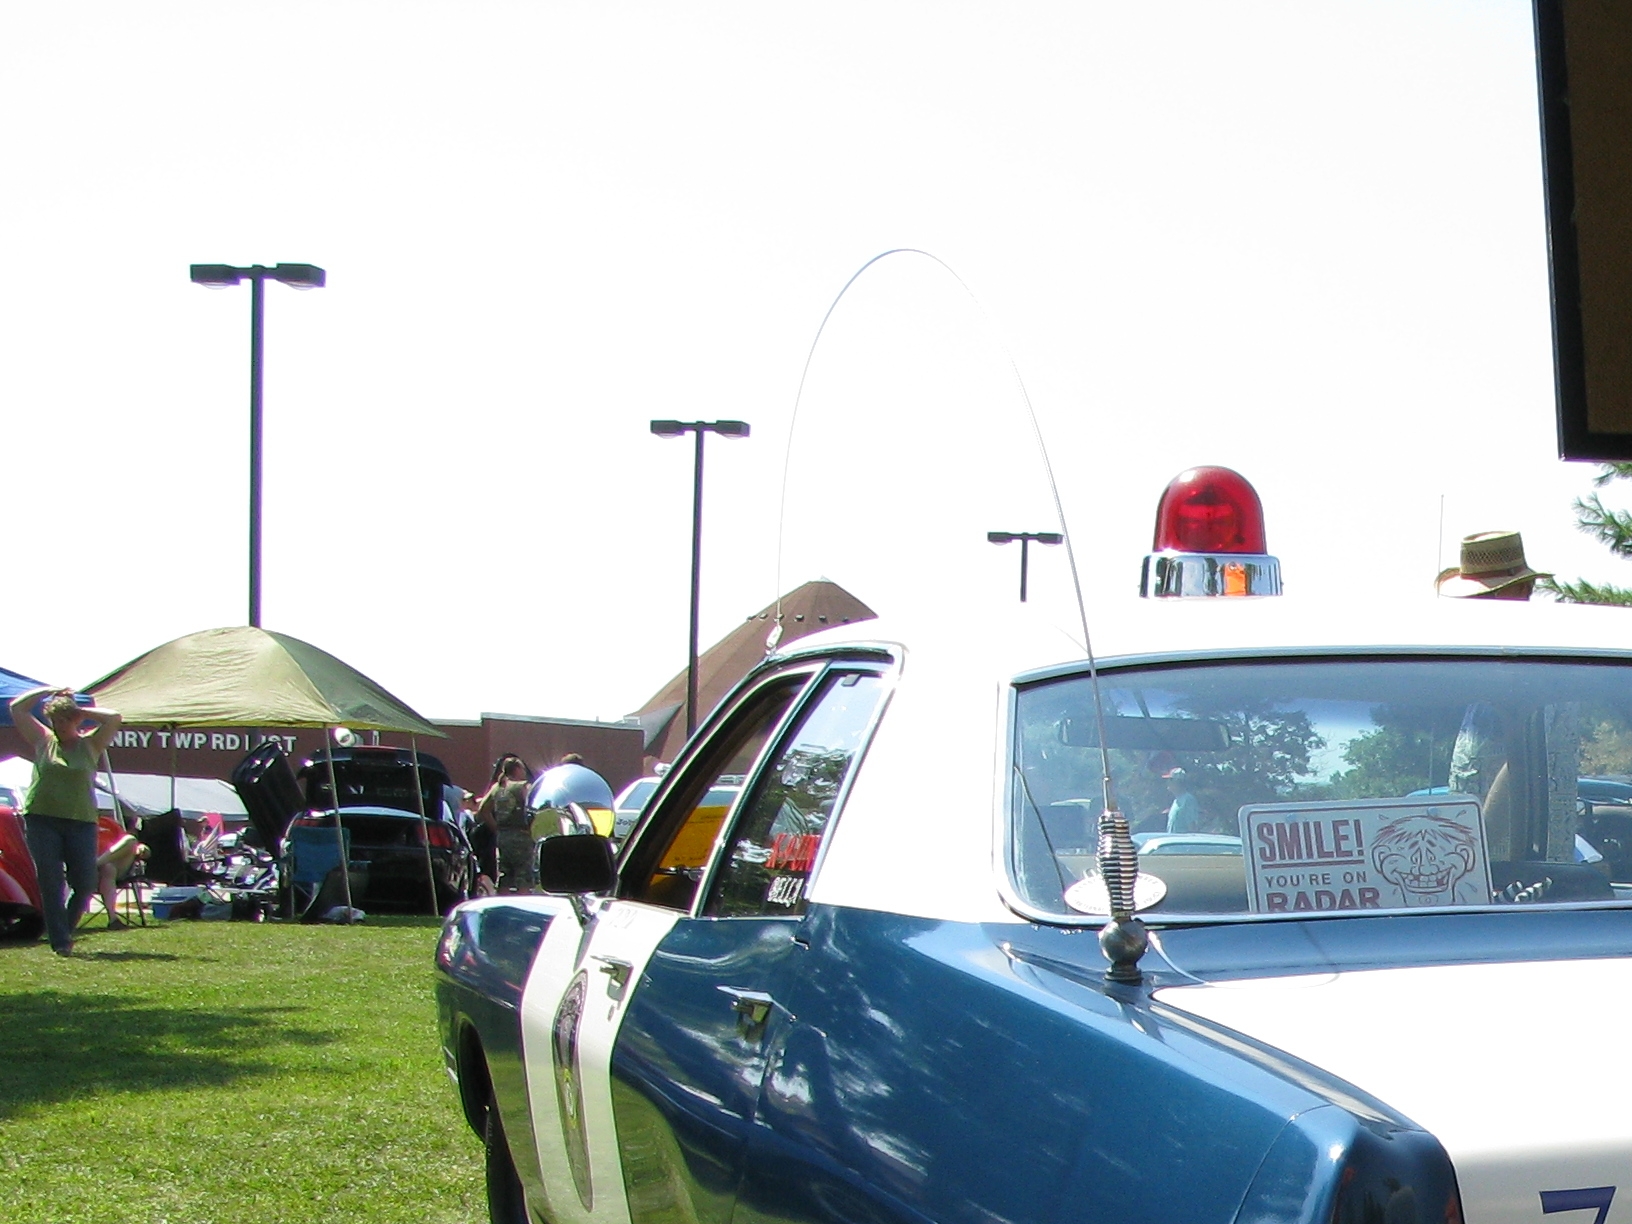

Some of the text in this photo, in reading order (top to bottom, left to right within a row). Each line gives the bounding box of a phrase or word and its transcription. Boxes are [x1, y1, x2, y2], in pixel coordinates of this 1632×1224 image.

[1257, 818, 1364, 863] SMILE!
[1265, 870, 1367, 888] YOU'RE ON
[1266, 887, 1380, 912] RADAR
